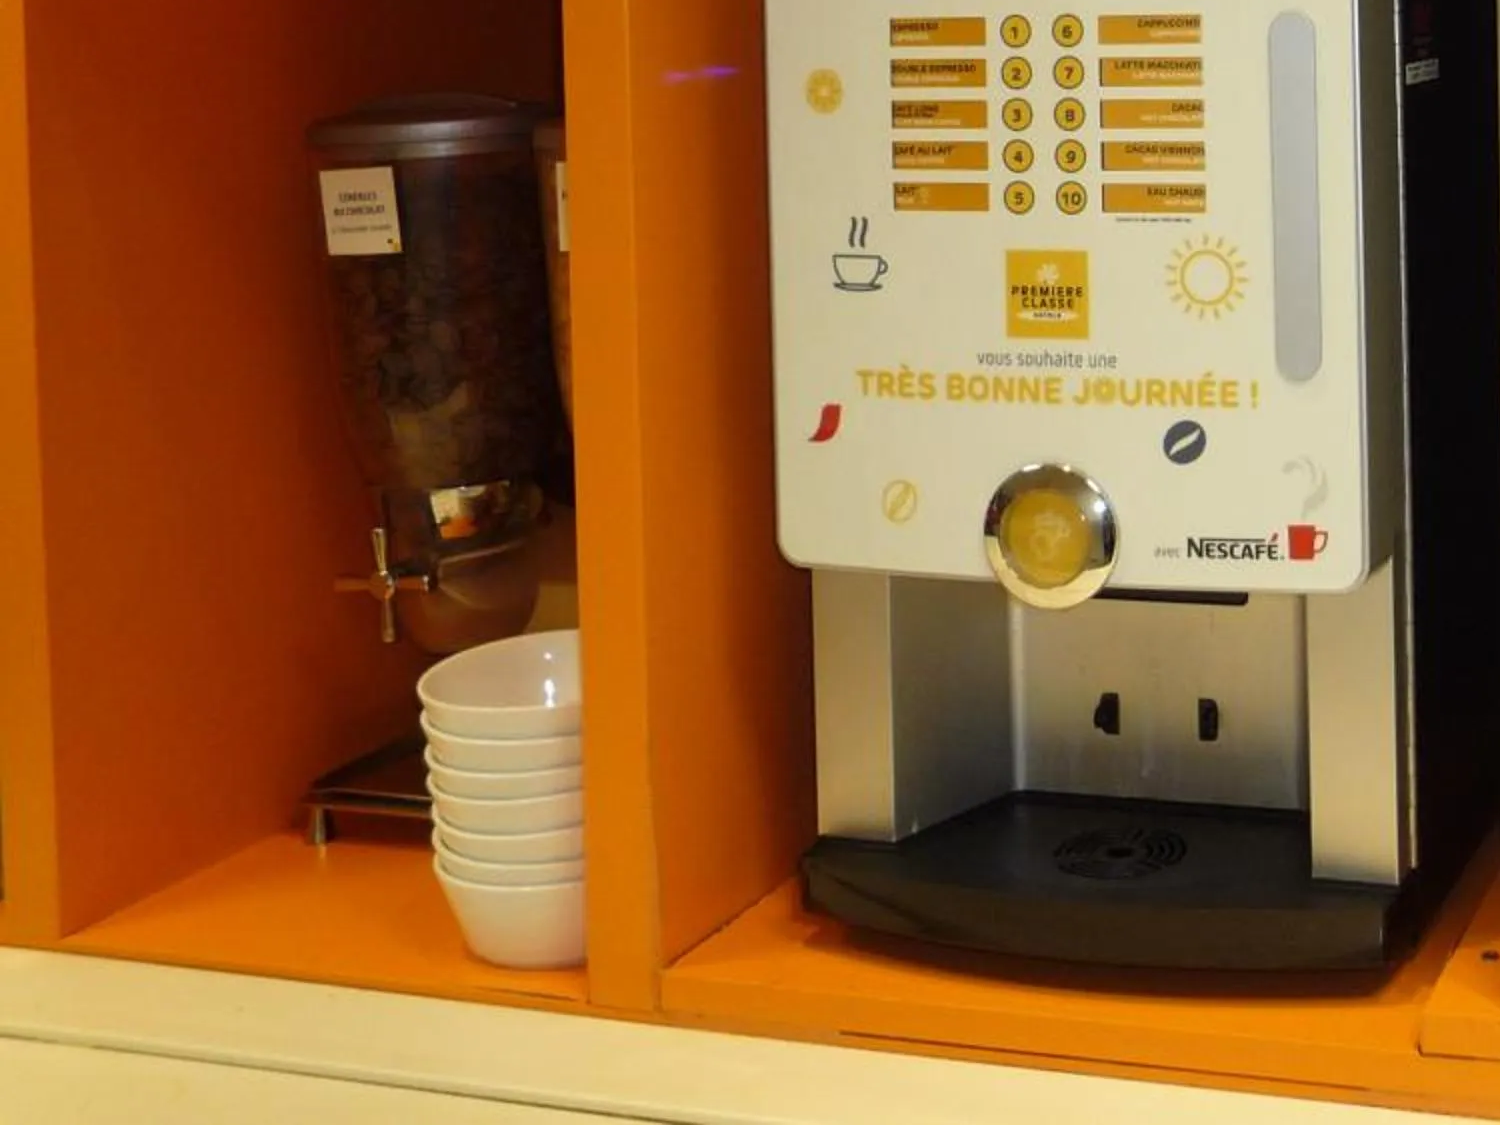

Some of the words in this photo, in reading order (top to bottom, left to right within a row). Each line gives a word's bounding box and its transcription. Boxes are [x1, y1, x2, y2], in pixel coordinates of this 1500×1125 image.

[1061, 26, 1073, 39] 6
[1011, 67, 1022, 81] 2
[1063, 66, 1074, 80] 7
[1012, 108, 1021, 123] 3
[1065, 108, 1075, 122] 8
[1013, 150, 1023, 163] 4
[1065, 150, 1076, 164] 9
[1014, 192, 1023, 205] 5
[1061, 191, 1081, 205] 10
[1022, 297, 1074, 309] CLASSE
[977, 352, 1012, 366] vous
[1016, 350, 1083, 368] souhaite
[1088, 354, 1117, 369] une
[857, 364, 936, 400] TRÈS
[945, 374, 1062, 403] BONNE
[1072, 372, 1239, 408] JOURNÉE
